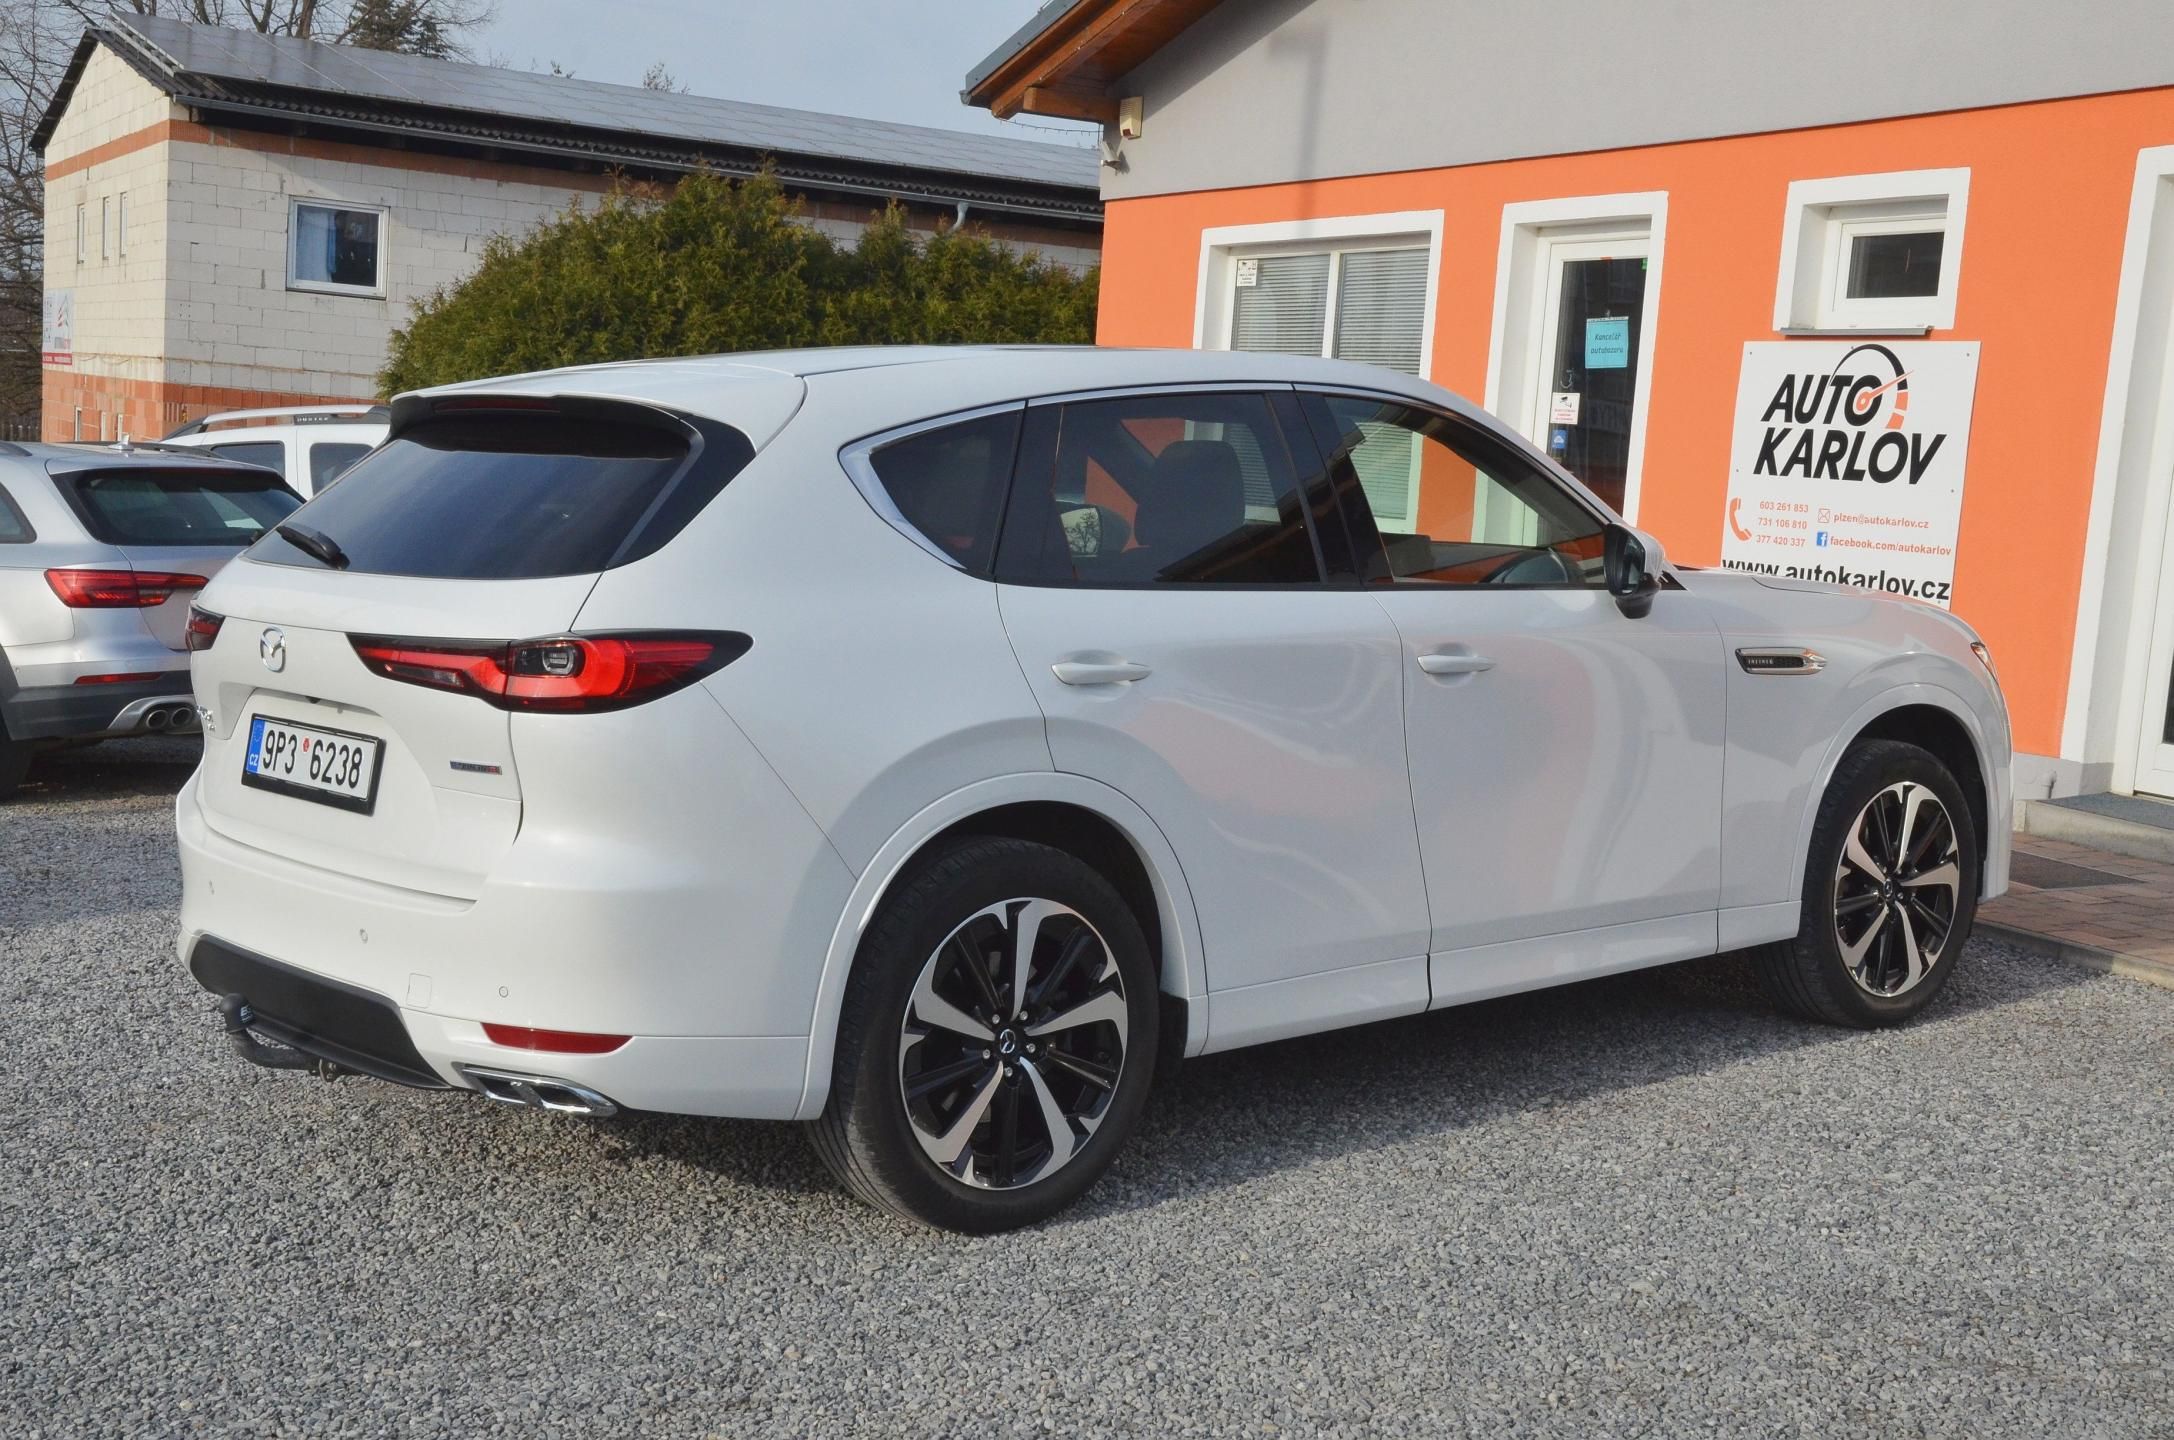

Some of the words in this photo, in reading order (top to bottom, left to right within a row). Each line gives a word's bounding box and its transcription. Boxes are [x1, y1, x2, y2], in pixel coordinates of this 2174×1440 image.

[1760, 374, 1883, 426] AUTO
[1753, 427, 1947, 485] KARLOV
[1759, 501, 1775, 510] 603
[1776, 502, 1791, 512] 261
[1793, 503, 1809, 513] 853
[1757, 517, 1772, 526] 731
[1775, 518, 1790, 528] 106
[1792, 520, 1807, 529] 810
[1833, 512, 1929, 529] plzen@autokarlov.cz
[1756, 535, 1771, 544] 377
[1773, 536, 1788, 545] 420
[1790, 537, 1806, 547] 337
[1830, 536, 1952, 556] facebook.com/autokarlov
[1722, 559, 1950, 600] wwwautokarlov.cz
[249, 753, 259, 766] CZ
[263, 729, 298, 774] 9P3
[310, 739, 363, 789] 6238
